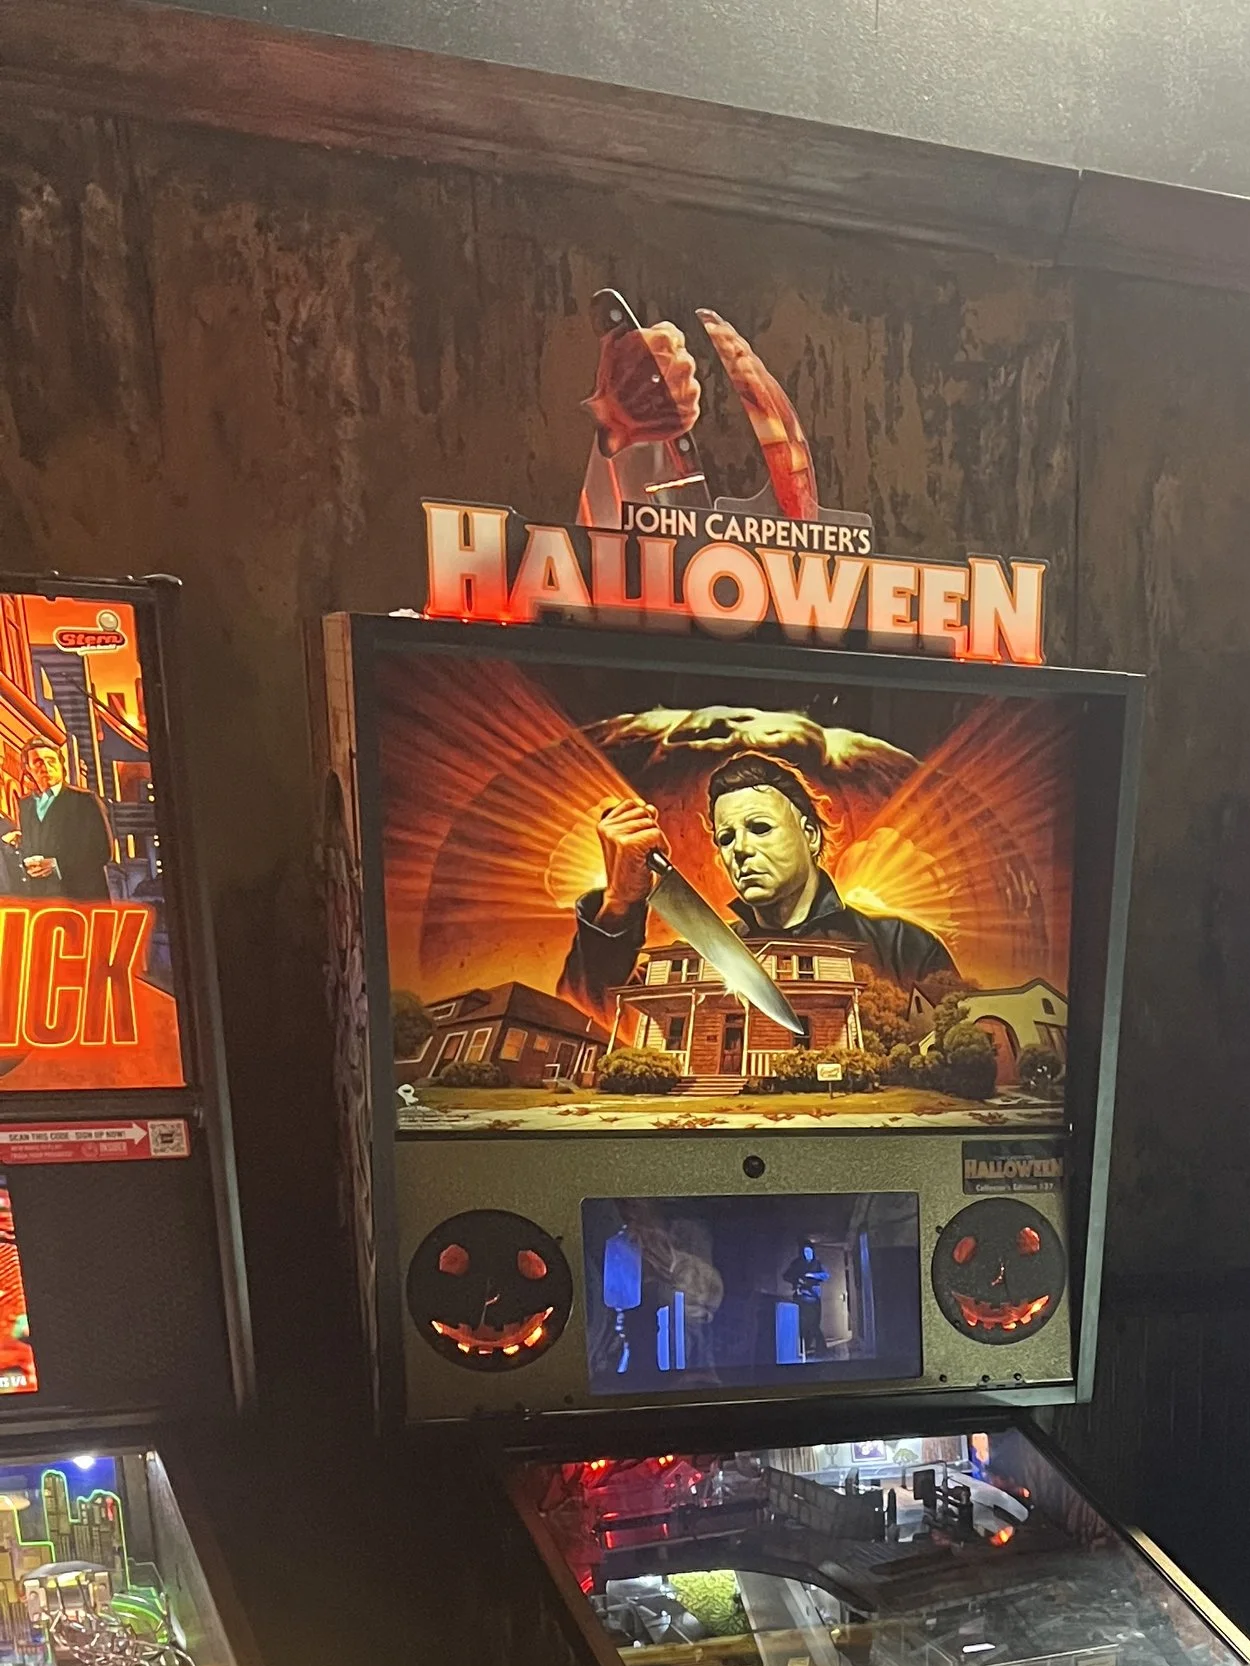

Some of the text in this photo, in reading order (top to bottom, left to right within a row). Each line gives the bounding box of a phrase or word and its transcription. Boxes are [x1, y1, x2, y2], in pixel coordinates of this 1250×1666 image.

[623, 503, 872, 555] JOHN CARPENTER'S
[422, 501, 1048, 665] HALLOWEEN
[61, 632, 124, 647] Stern
[8, 1133, 30, 1142] SCAN
[31, 1133, 48, 1141] THIS
[50, 1132, 69, 1141] CODE
[964, 1158, 1062, 1178] HALLOWEEN
